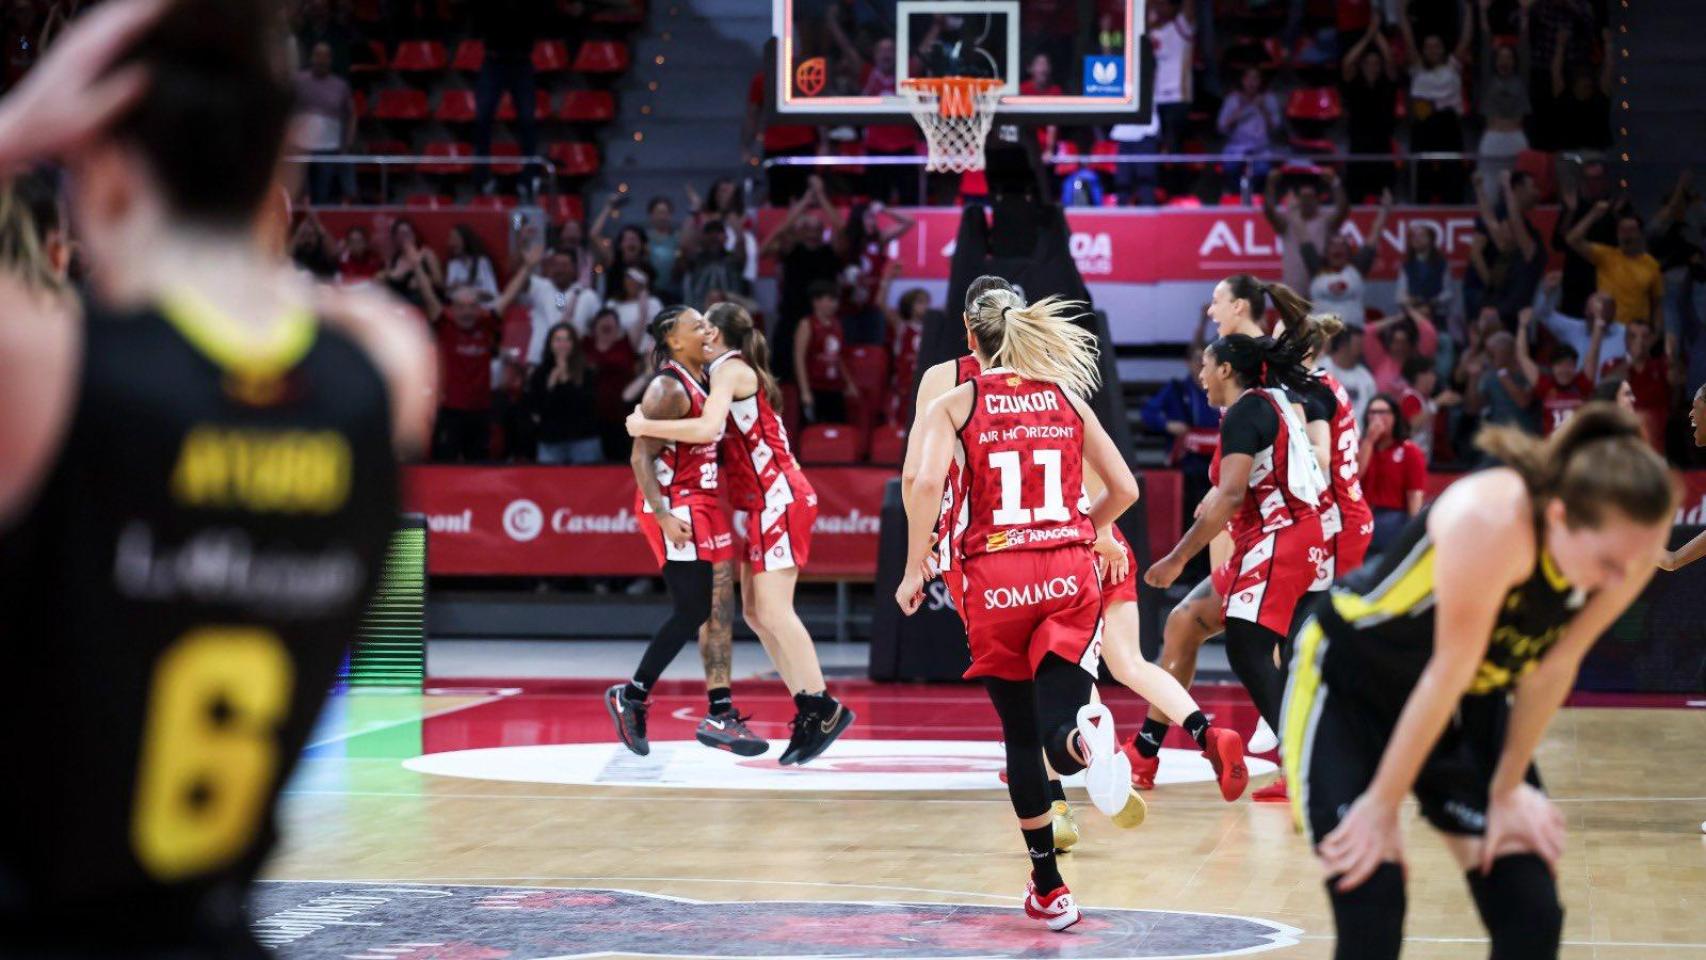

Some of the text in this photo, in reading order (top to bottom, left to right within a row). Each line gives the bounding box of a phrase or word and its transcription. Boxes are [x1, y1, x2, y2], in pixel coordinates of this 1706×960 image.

[985, 389, 1059, 415] CZUKOR
[979, 425, 1075, 444] AIR HORIZONT
[988, 449, 1071, 525] 11
[551, 508, 641, 534] Casade
[1008, 536, 1026, 546] DE
[984, 575, 1079, 610] SOMMOS
[132, 624, 294, 882] 6
